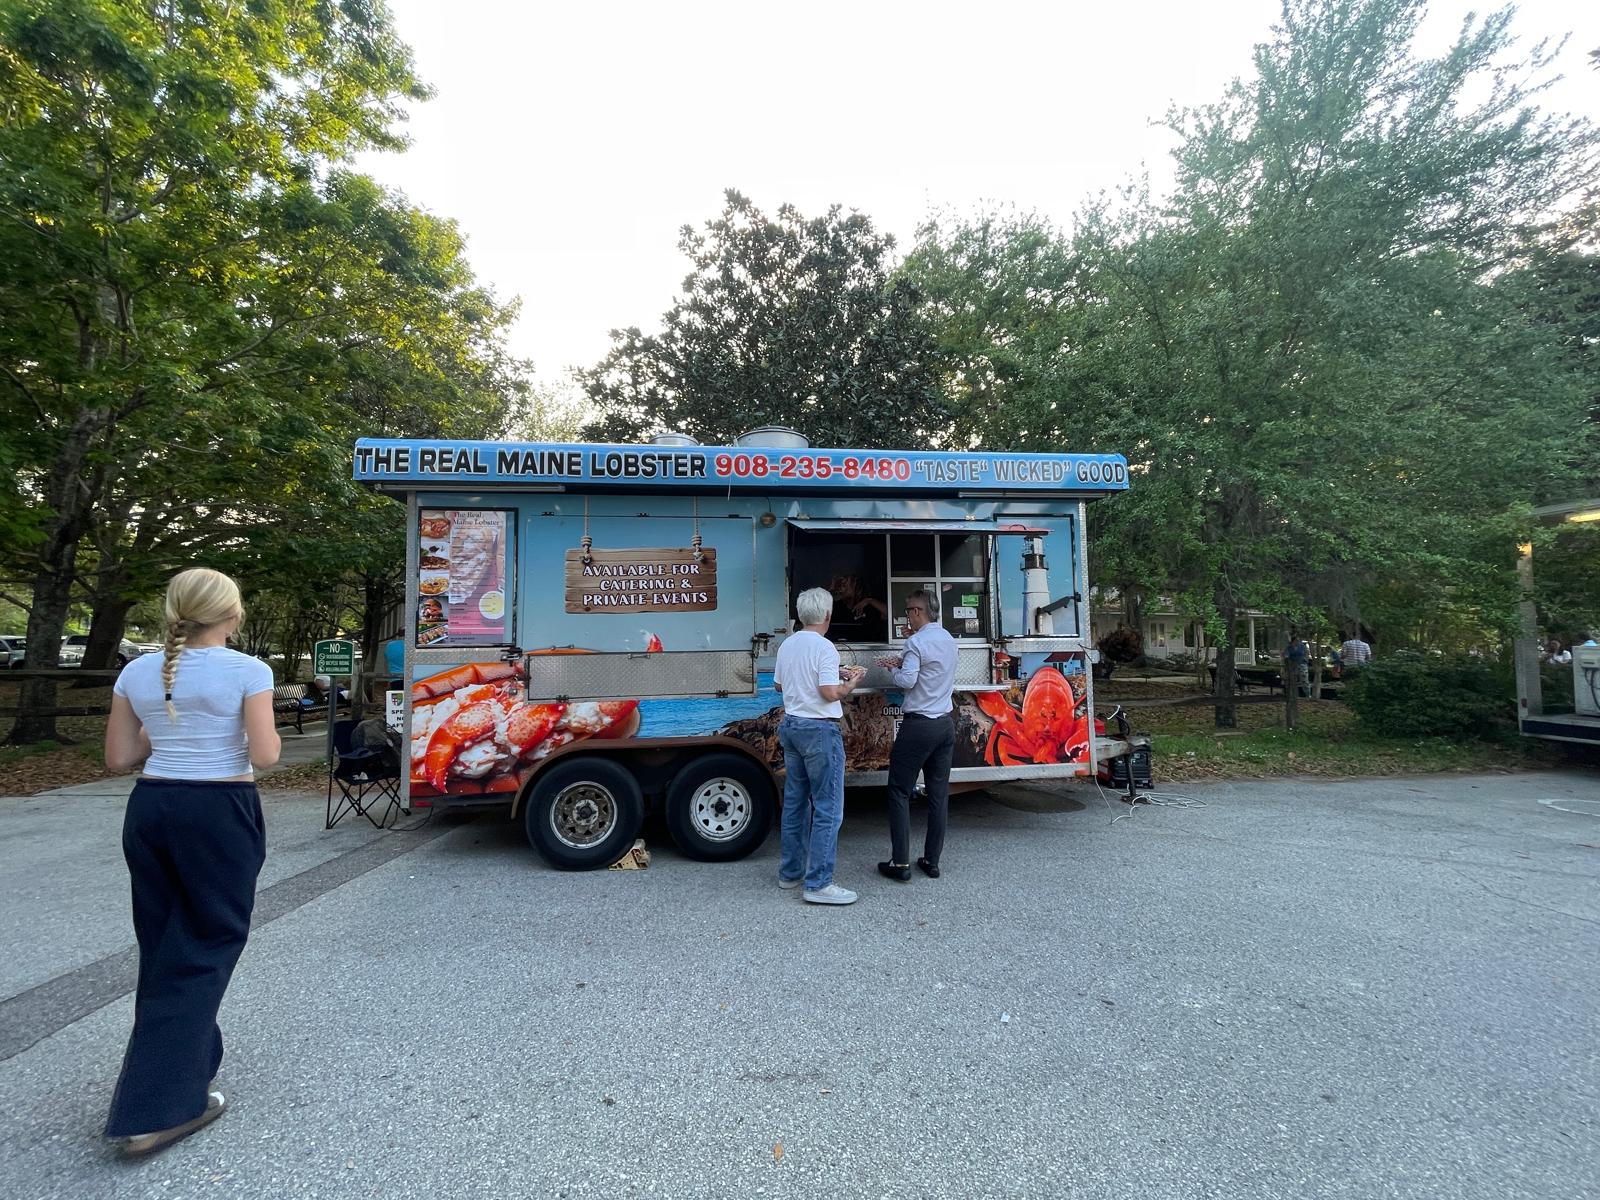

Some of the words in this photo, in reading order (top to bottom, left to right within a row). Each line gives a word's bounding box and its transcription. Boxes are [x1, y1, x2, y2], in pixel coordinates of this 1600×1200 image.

[355, 447, 410, 474] THE
[418, 447, 488, 475] REAL
[497, 452, 583, 477] MAINE
[591, 452, 706, 478] LOBSTER
[715, 453, 911, 481] 908-235-8480
[1076, 461, 1126, 484] GOOD
[583, 564, 666, 576] AVAILABLE
[672, 564, 700, 575] FOR
[600, 578, 675, 591] CATERING
[681, 578, 692, 588] &
[583, 593, 647, 606] PRIVATE
[653, 592, 708, 604] EVENTS
[329, 643, 340, 653] NO
